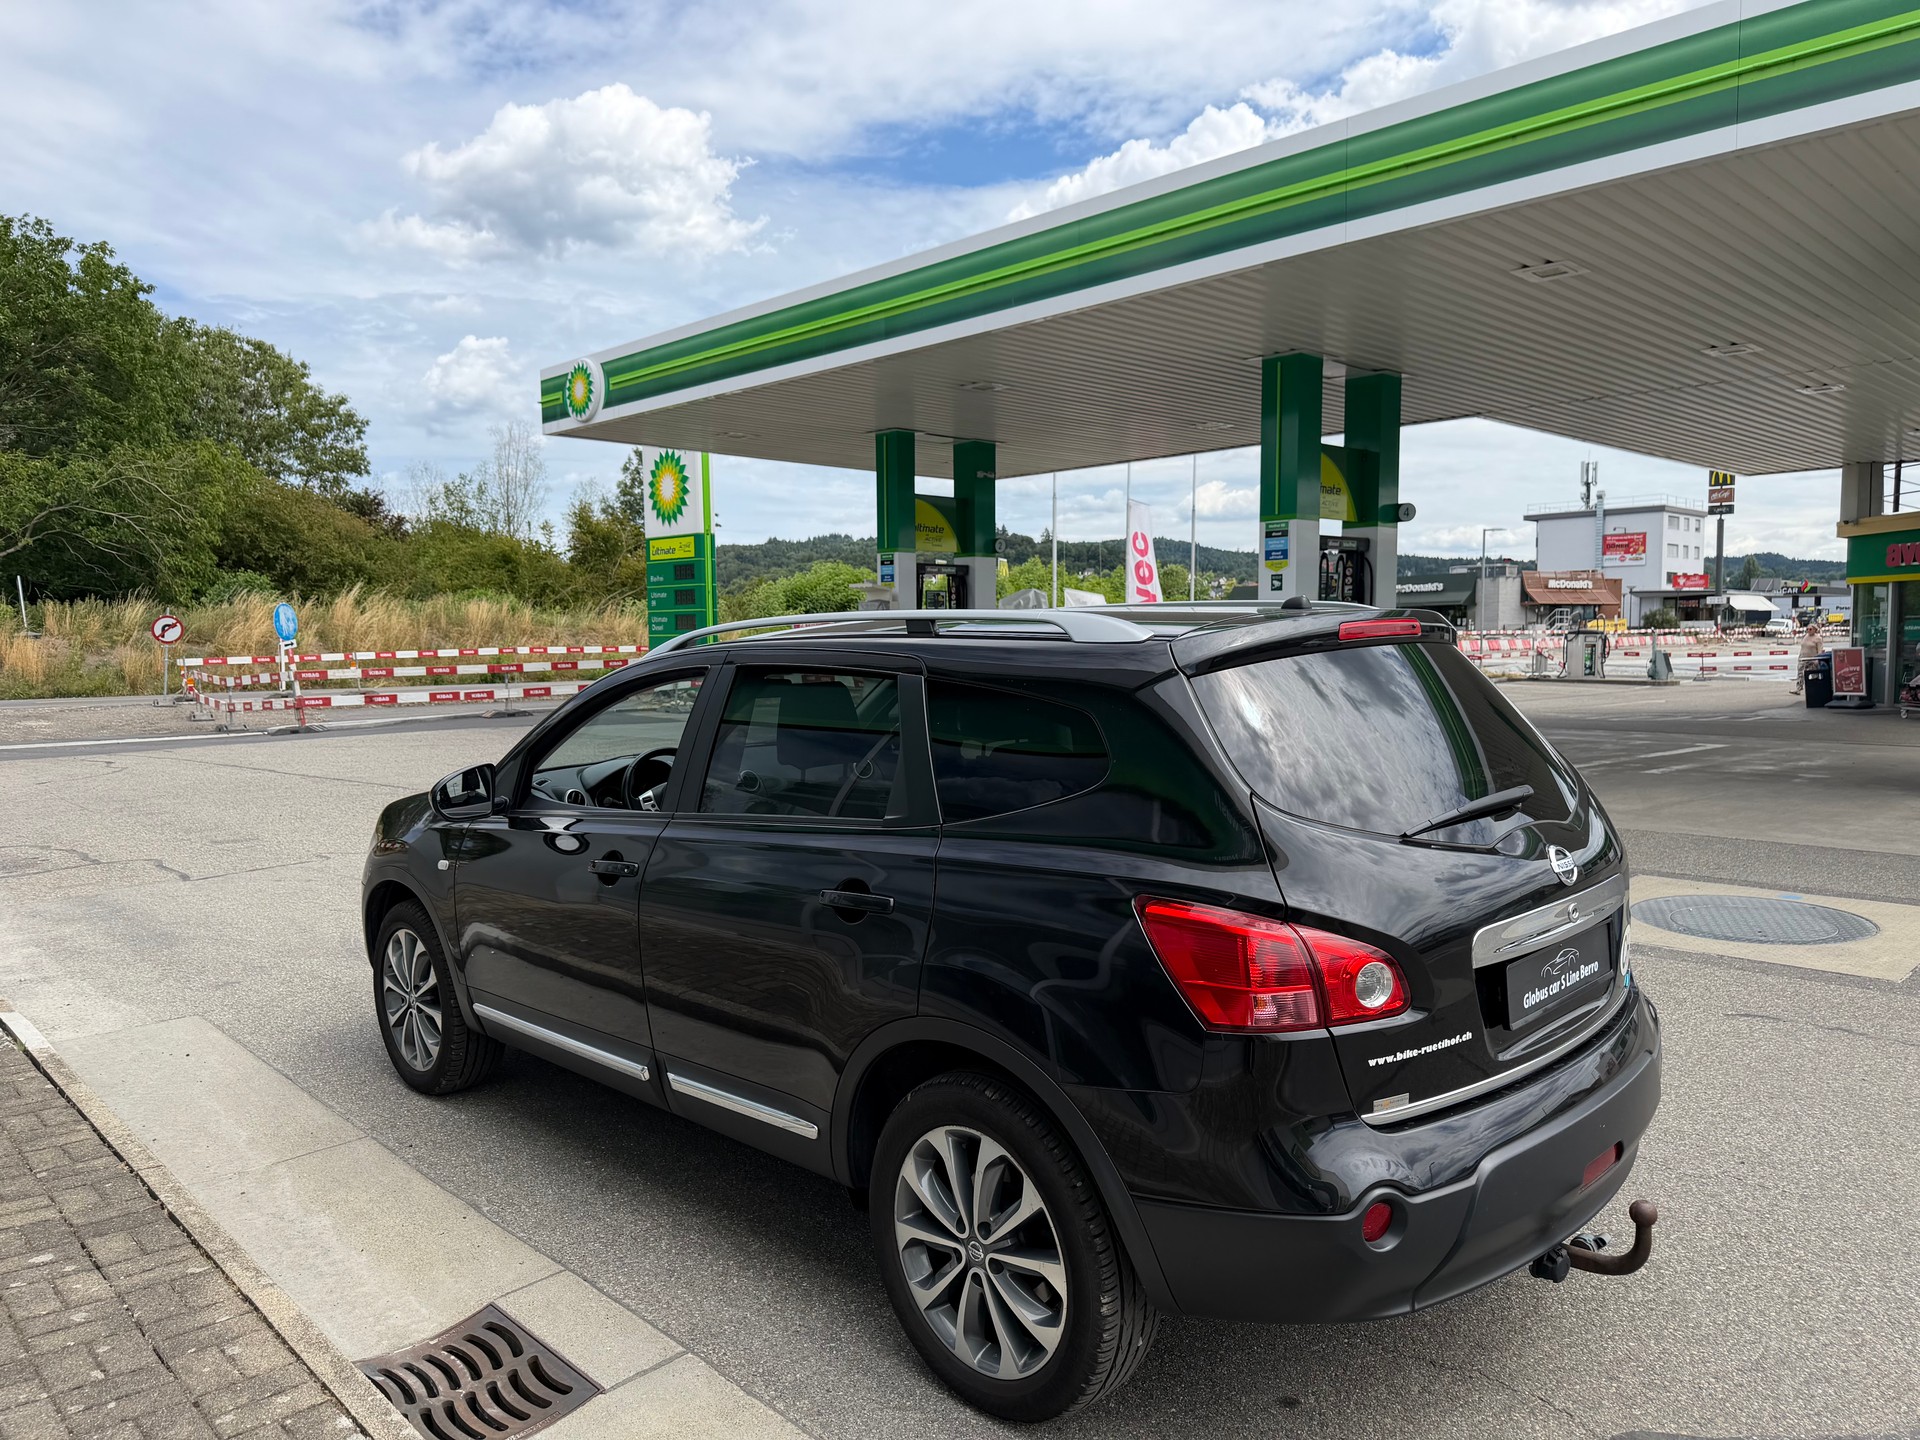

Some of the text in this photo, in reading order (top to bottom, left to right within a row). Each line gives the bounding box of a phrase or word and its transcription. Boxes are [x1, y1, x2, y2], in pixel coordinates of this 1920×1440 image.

[1403, 507, 1409, 517] 4
[1548, 579, 1592, 589] McDonald's
[1557, 860, 1574, 870] NISS
[1524, 961, 1599, 1009] Globus car S Line Berro
[1368, 1031, 1472, 1067] www.bike-ruetihof.ch
